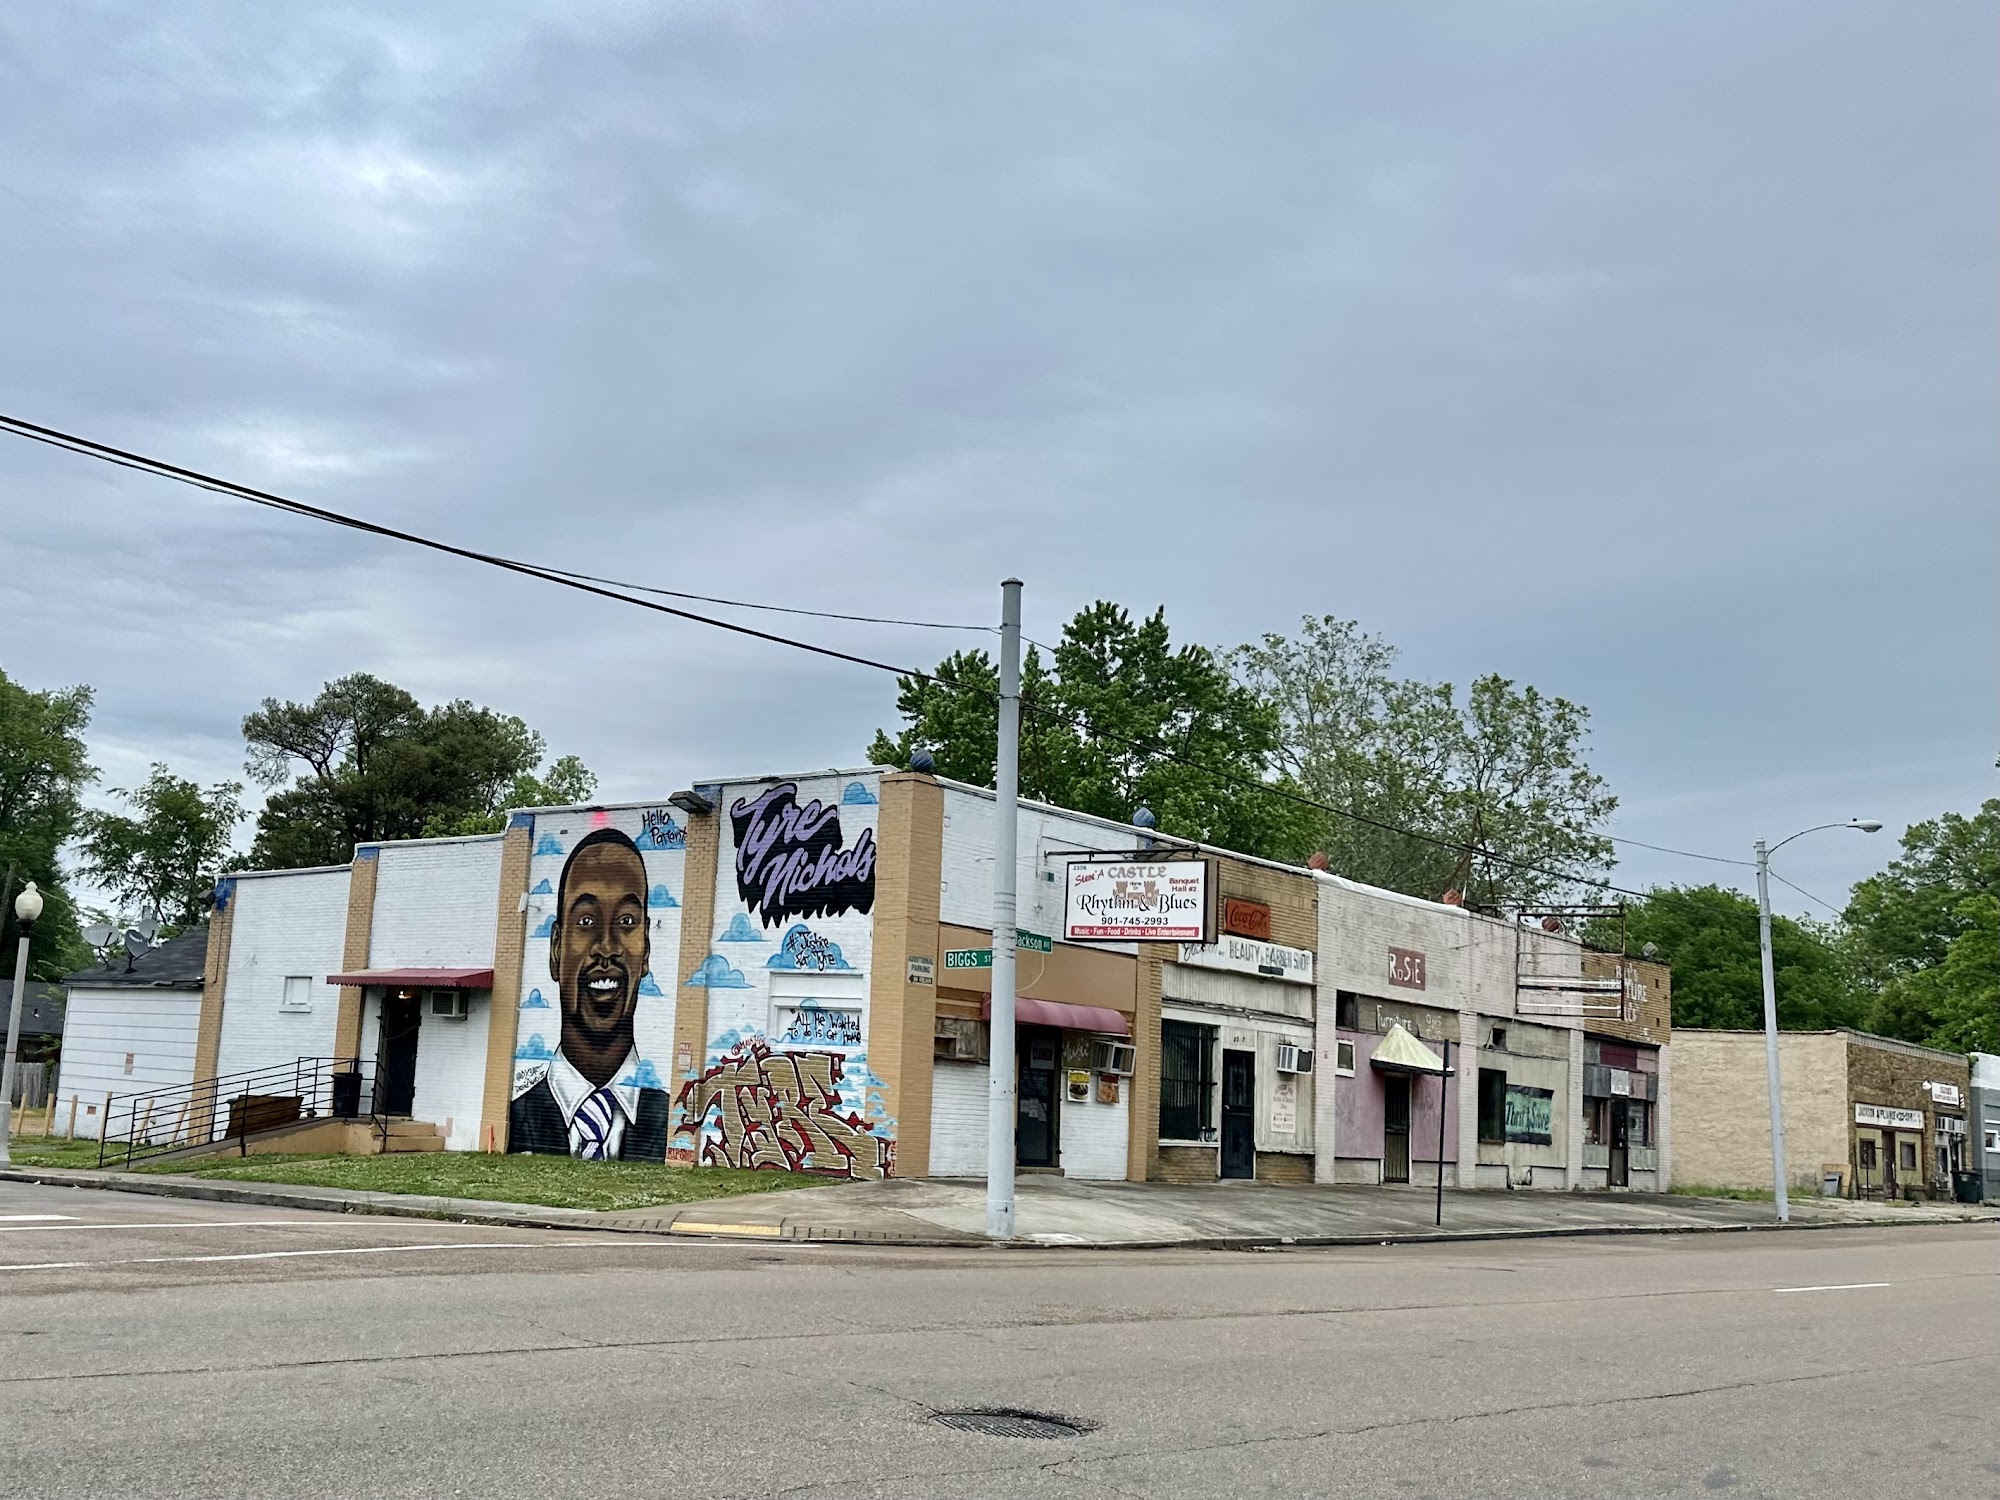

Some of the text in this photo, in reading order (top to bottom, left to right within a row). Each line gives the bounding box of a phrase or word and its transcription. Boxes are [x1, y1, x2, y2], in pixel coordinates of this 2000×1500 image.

[642, 809, 670, 829] Hello
[731, 784, 838, 885] Tyre
[759, 829, 876, 911] Nichols
[1107, 865, 1167, 879] CASTLE
[1169, 877, 1199, 885] Banquet
[1076, 893, 1134, 916] Rhythm
[1153, 893, 1197, 914] Blues
[1101, 916, 1169, 926] 901-745-2993
[1230, 905, 1268, 933] Coca-Cola
[1015, 931, 1043, 950] Jackson
[1074, 926, 1195, 937] Music Fun Food Drinks Live Entertainment
[811, 950, 836, 972] Tyre
[908, 955, 934, 966] ADDITIONAL
[947, 952, 978, 967] BIGGS
[1229, 940, 1261, 963] BEAUTY
[911, 964, 930, 974] PARKING
